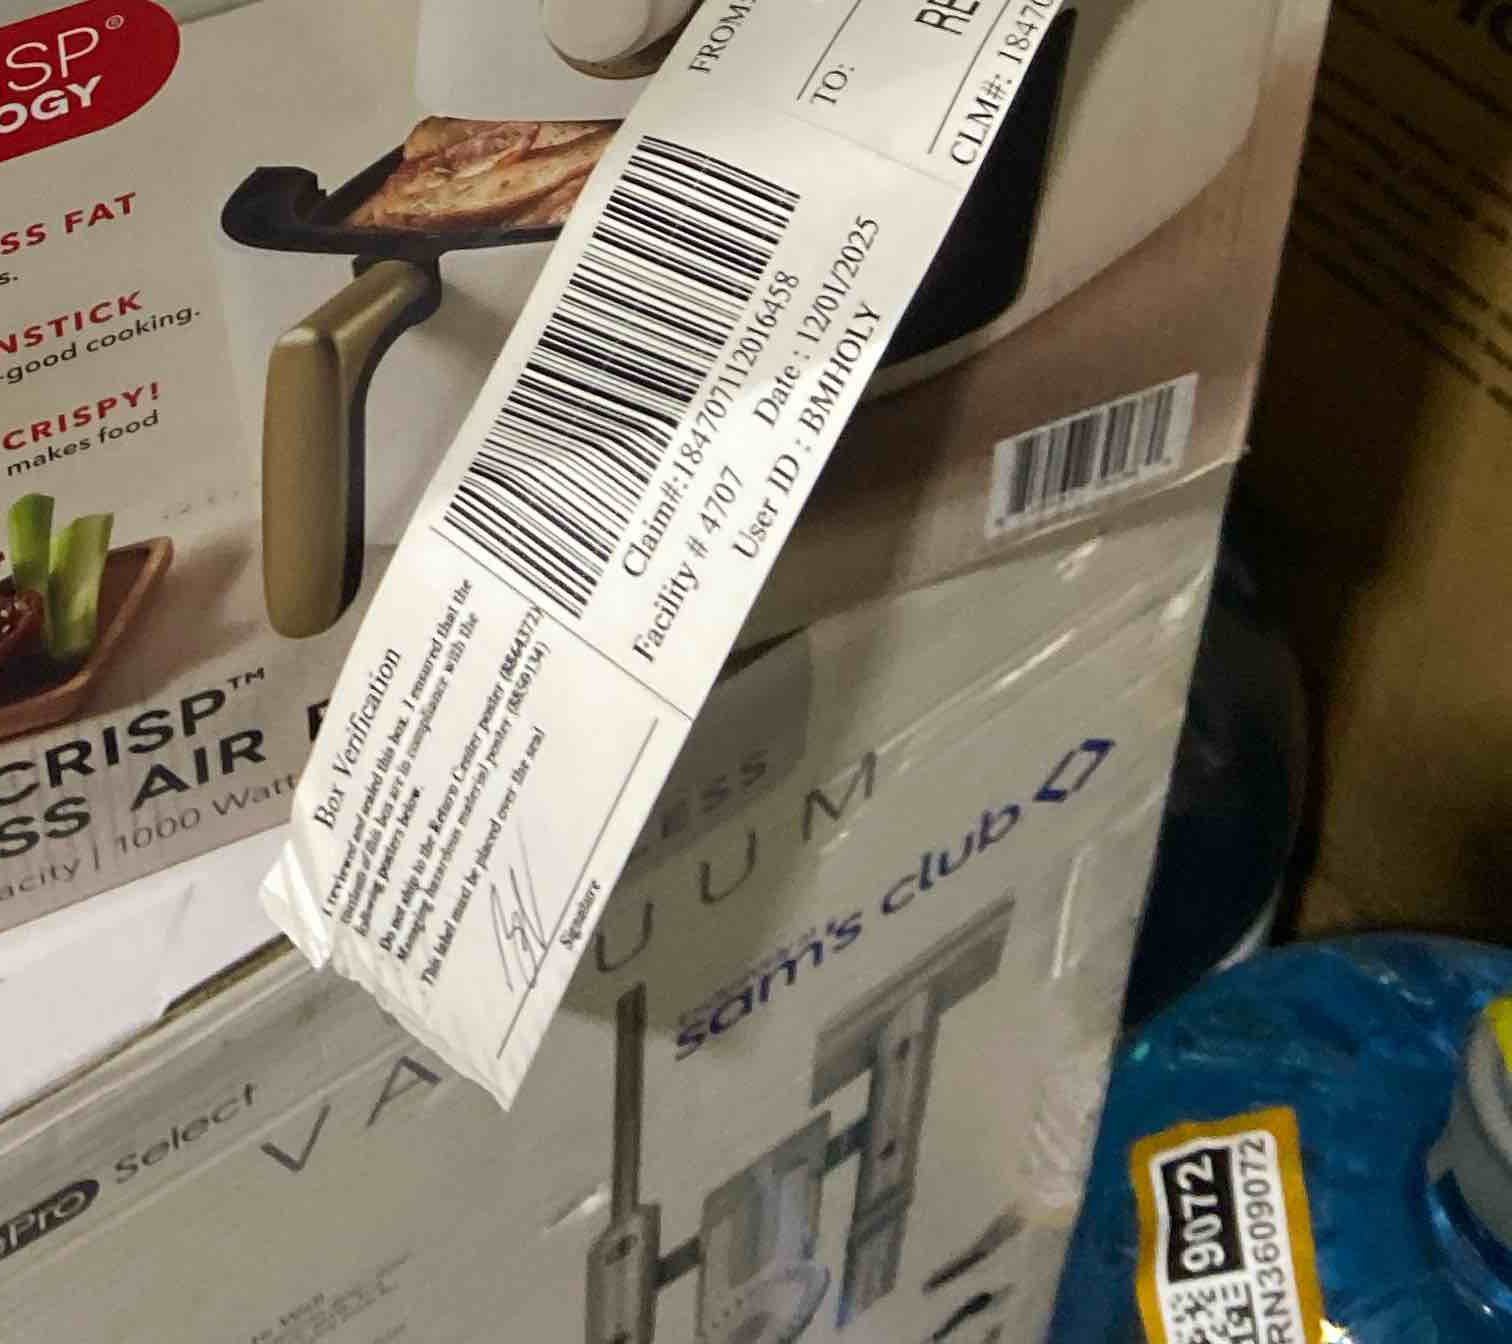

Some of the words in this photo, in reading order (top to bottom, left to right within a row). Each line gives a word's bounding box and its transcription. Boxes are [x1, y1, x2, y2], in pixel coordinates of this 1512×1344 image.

[810, 64, 856, 108] TO:
[950, 72, 1014, 168] CLM#:
[65, 192, 136, 234] FAT
[86, 305, 200, 353] cooking.
[2, 382, 159, 450] CRISPY!
[7, 437, 91, 477] makes
[98, 409, 160, 444] food
[633, 557, 701, 664] Facility
[701, 464, 746, 534] 4707
[754, 364, 801, 428] Date
[797, 214, 880, 345] 12/01/2025
[732, 502, 780, 561] User
[782, 452, 803, 495] ID
[799, 302, 883, 437] BMHOLY
[445, 638, 466, 674] with
[459, 612, 479, 639] the
[314, 785, 345, 830] Box
[332, 648, 401, 778] Verification
[479, 681, 506, 733] poster
[131, 729, 266, 812] AIR
[327, 840, 357, 906] reviewed
[376, 746, 395, 775] this
[410, 637, 443, 702] ensured
[437, 605, 460, 641] that
[452, 578, 473, 605] the
[452, 732, 482, 783] Center
[458, 762, 489, 828] material
[486, 718, 512, 769] poster
[116, 807, 201, 855] 1000
[428, 783, 459, 834] Return
[377, 829, 405, 882] posters
[412, 859, 427, 874] to
[419, 835, 436, 859] the
[421, 958, 443, 986] This
[433, 919, 456, 958] label
[451, 885, 472, 924] must
[464, 867, 481, 888] be
[475, 817, 503, 872] placed
[497, 788, 517, 823] over
[511, 759, 531, 787] the
[526, 725, 546, 760] seal
[881, 805, 1021, 916] club
[392, 904, 407, 930] not
[400, 875, 421, 907] ship
[559, 878, 603, 954] Signature
[378, 930, 396, 952] Do
[114, 1082, 257, 1185] Select
[1176, 1154, 1226, 1273] 9072
